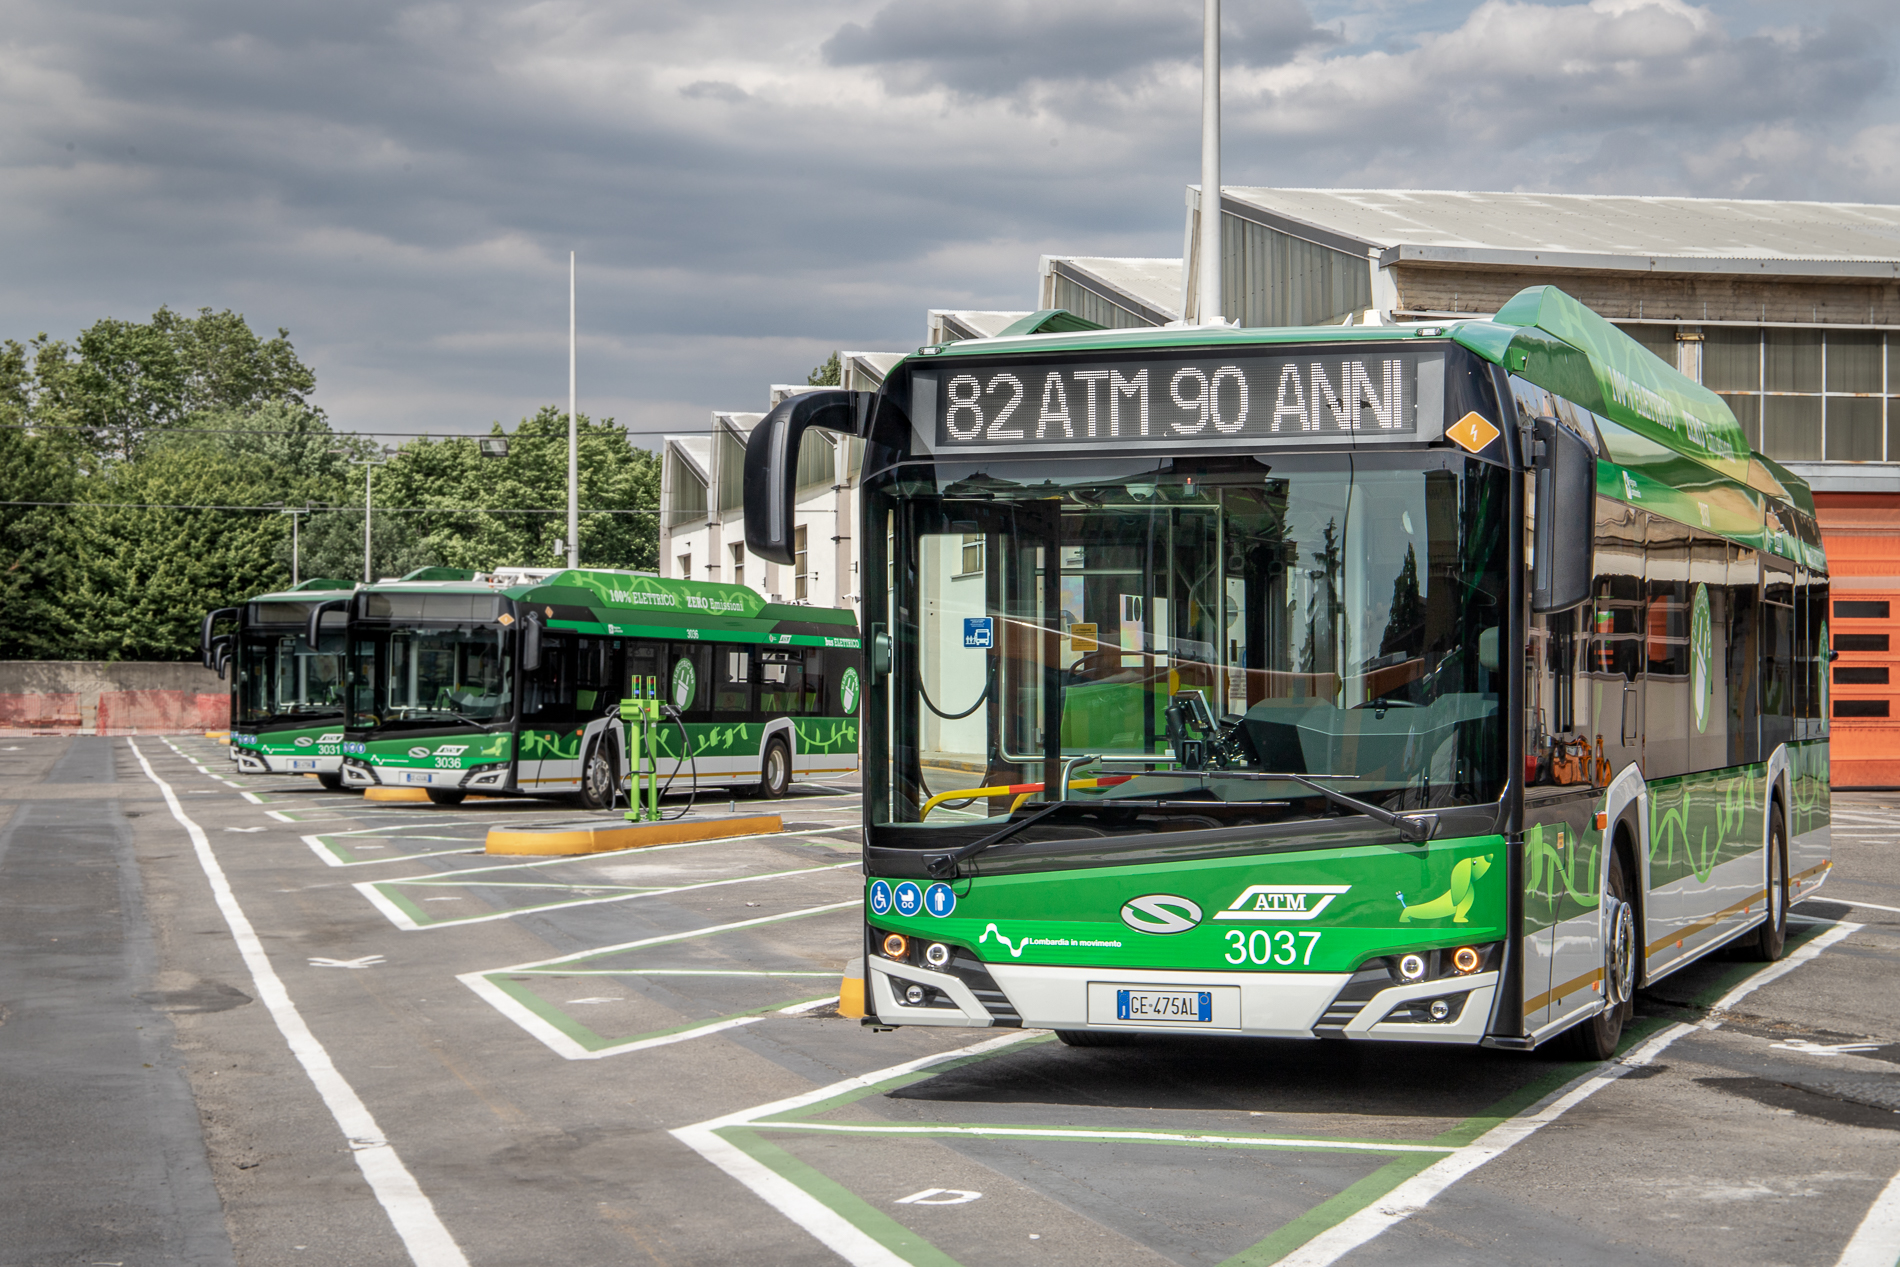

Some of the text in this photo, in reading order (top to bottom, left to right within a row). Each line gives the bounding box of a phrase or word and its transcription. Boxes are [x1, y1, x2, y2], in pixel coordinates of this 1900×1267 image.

[946, 359, 1402, 440] 82 ATM 90 ANNI
[609, 589, 744, 612] 100% ELETTRICO ZERO Emissioni
[686, 629, 699, 639] 3036
[834, 638, 860, 648] ELETTRICO
[318, 744, 341, 755] 3031
[434, 756, 462, 769] 3036
[1252, 893, 1307, 911] ATM
[1029, 937, 1123, 948] Lombardia in movimento
[1224, 929, 1322, 966] 3037
